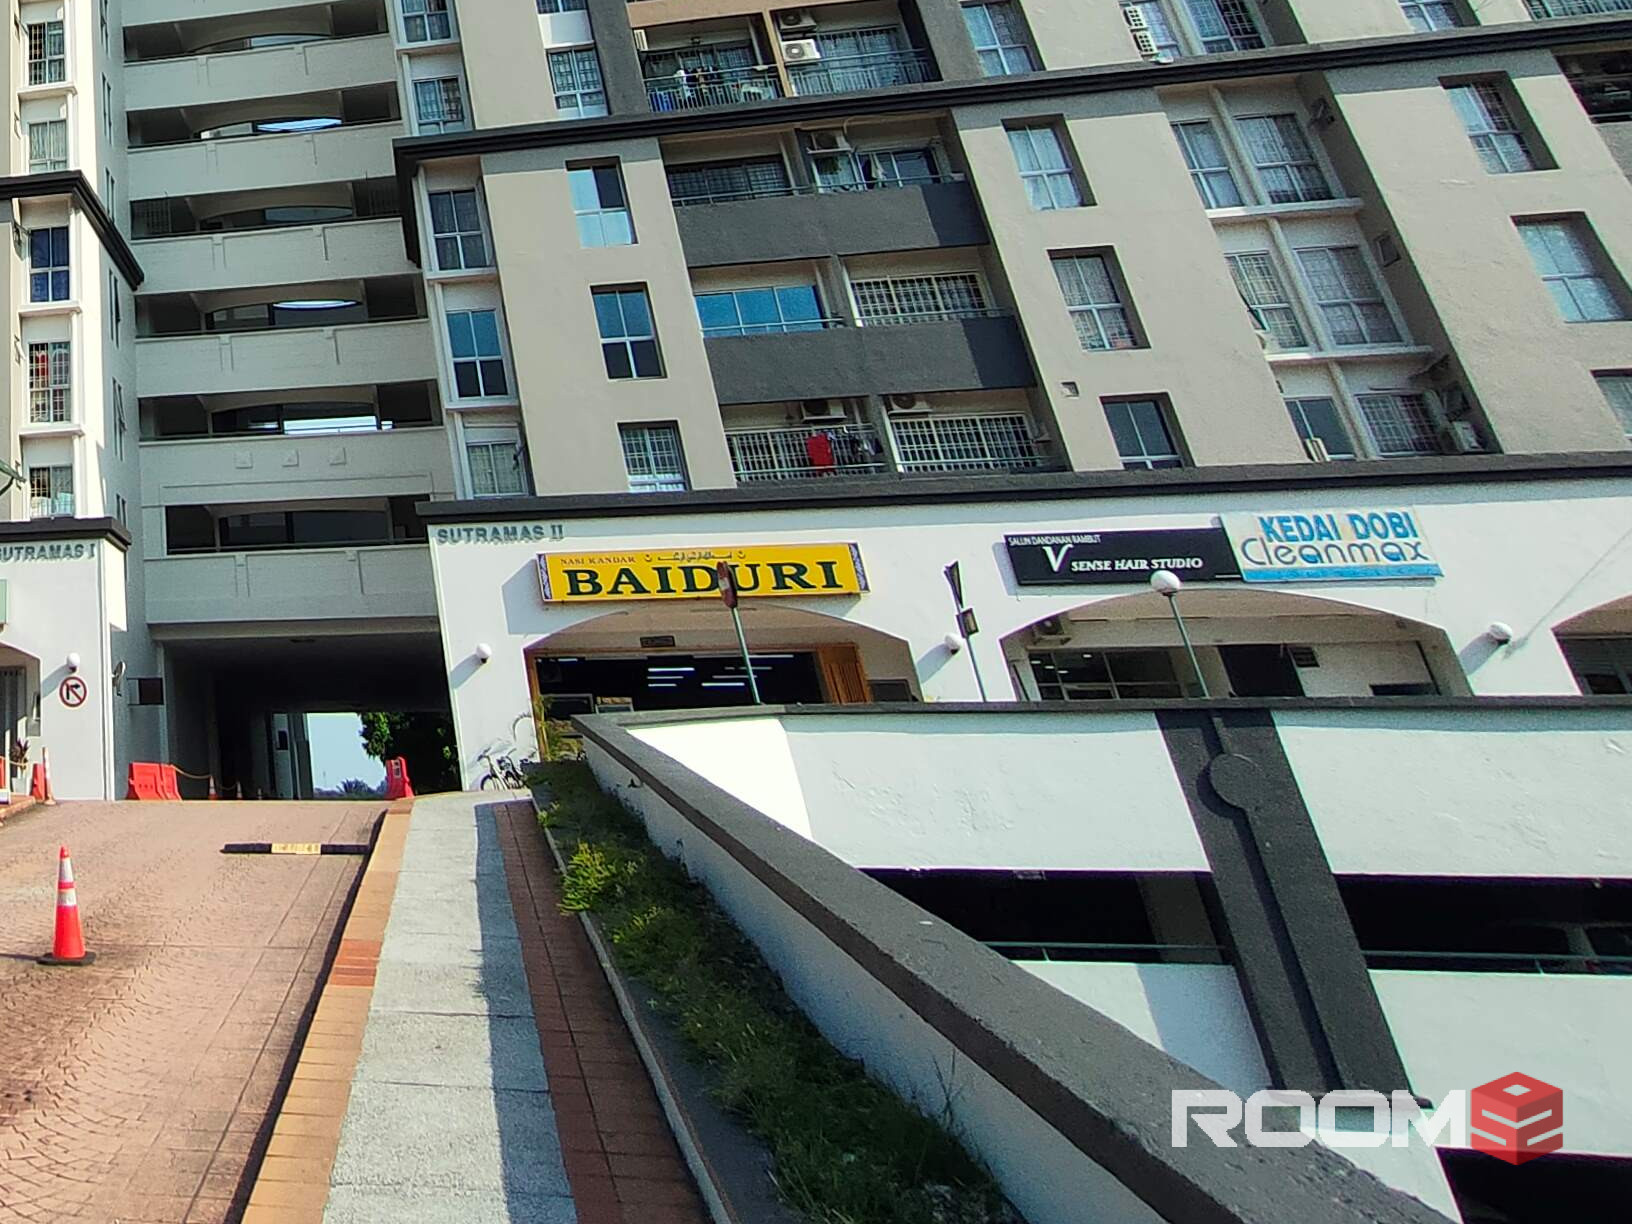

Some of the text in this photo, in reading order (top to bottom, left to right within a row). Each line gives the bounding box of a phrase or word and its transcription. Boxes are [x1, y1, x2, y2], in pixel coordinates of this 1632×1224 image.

[437, 525, 564, 544] SUTRAMAS II
[1258, 511, 1419, 543] KEDAI DOBI
[589, 556, 636, 564] KANDAR
[1042, 544, 1204, 572] V SENSE HAIR STUDIO
[1241, 537, 1430, 566] Cleanmax
[562, 561, 844, 596] BAIDURI
